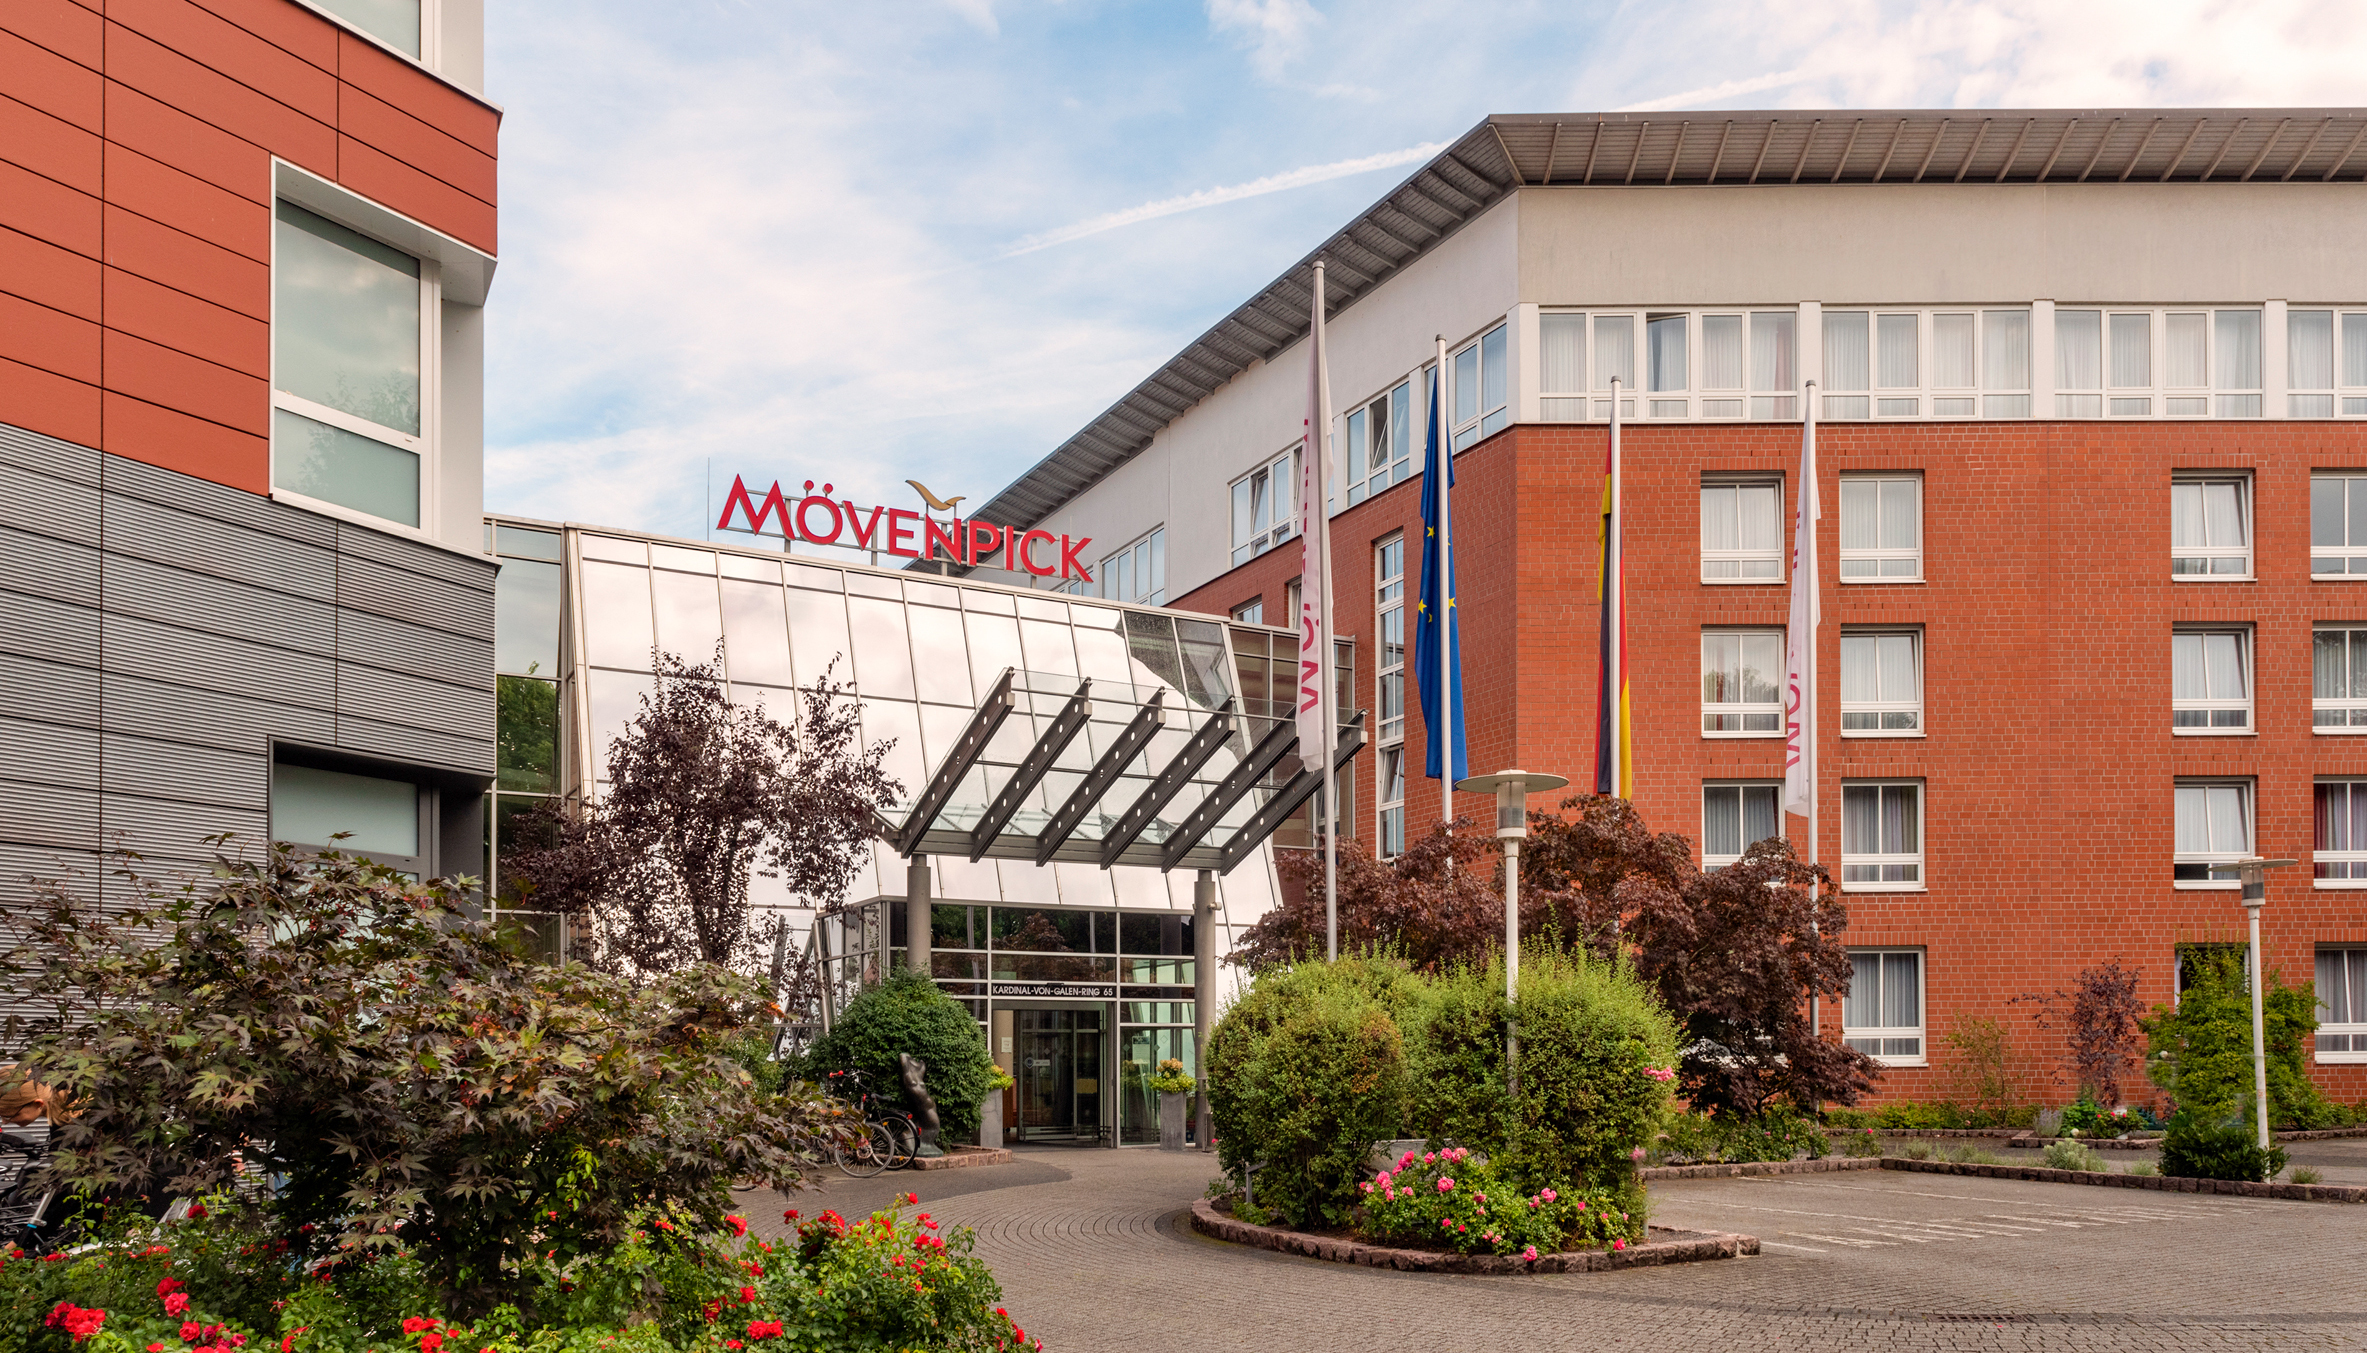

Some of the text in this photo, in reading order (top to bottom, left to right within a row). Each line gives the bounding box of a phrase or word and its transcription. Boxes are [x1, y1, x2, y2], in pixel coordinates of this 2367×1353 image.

[717, 473, 1093, 583] MÖVENPICK
[992, 985, 1113, 996] KARDINAL-VON-GALEN-RING 65
